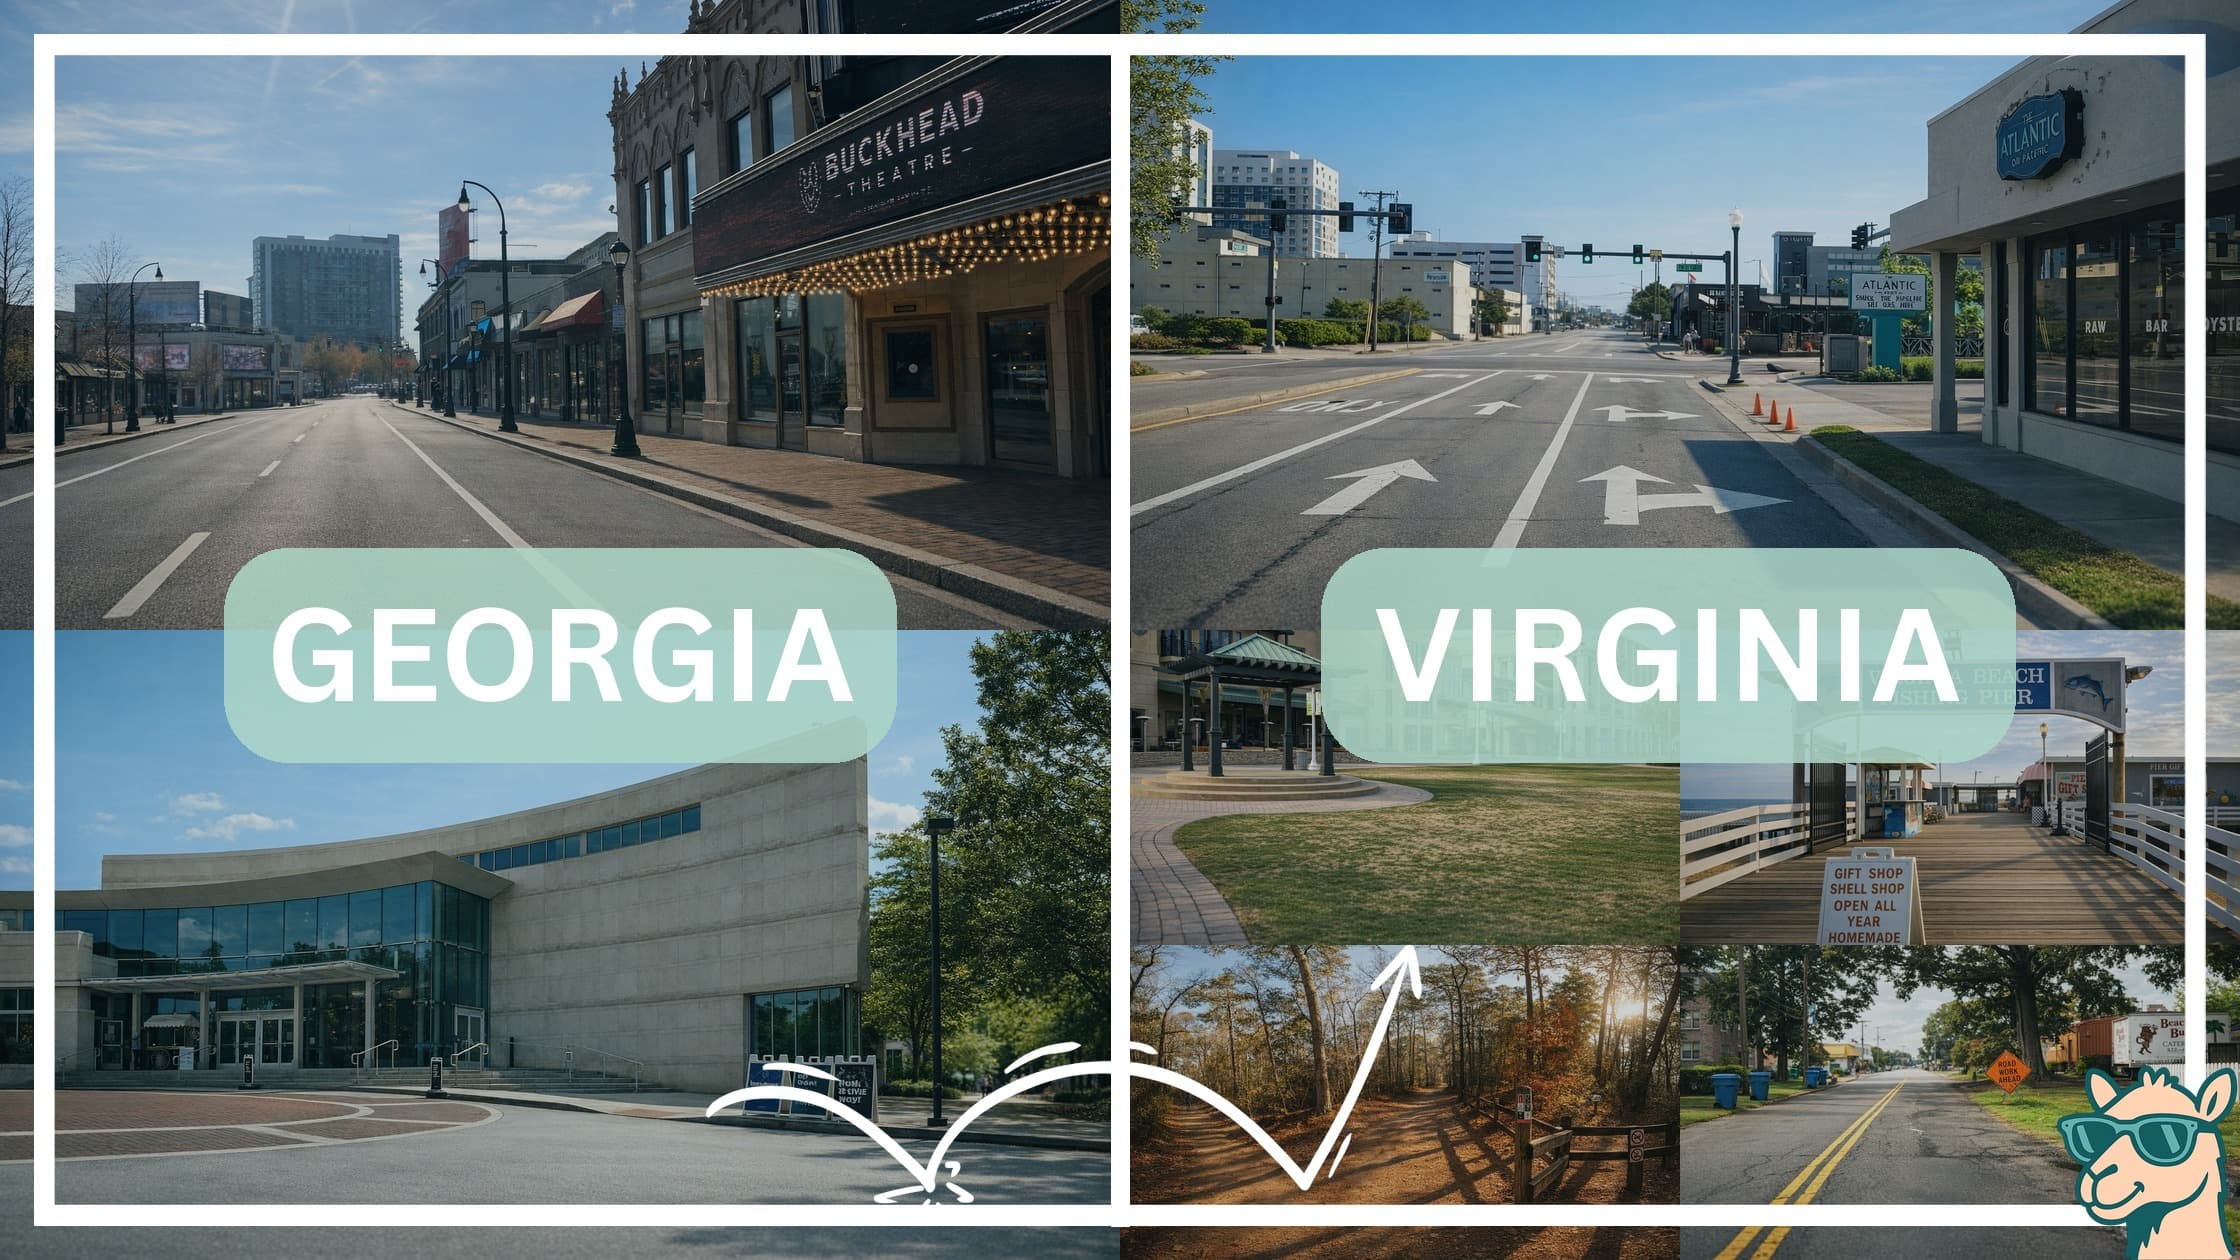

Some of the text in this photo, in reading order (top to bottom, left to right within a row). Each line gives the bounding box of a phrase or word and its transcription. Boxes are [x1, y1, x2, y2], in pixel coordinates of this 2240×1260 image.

[825, 90, 984, 181] BUCKHEAD
[2000, 112, 2060, 158] ATLANTIC
[847, 146, 952, 196] THEATRE
[1862, 280, 1917, 290] ATLANTIC
[2085, 319, 2168, 334] RAW BAR
[2058, 782, 2079, 794] GIFT
[1834, 868, 1904, 879] GIFT SHOP
[1830, 883, 1905, 894] SHELL SHOP
[1833, 900, 1897, 911] OPEN ALL
[1847, 916, 1881, 927] YEAR
[1828, 932, 1901, 943] HOMEMADE
[2160, 1018, 2185, 1029] Beac
[1999, 1075, 2021, 1083] AHEAD
